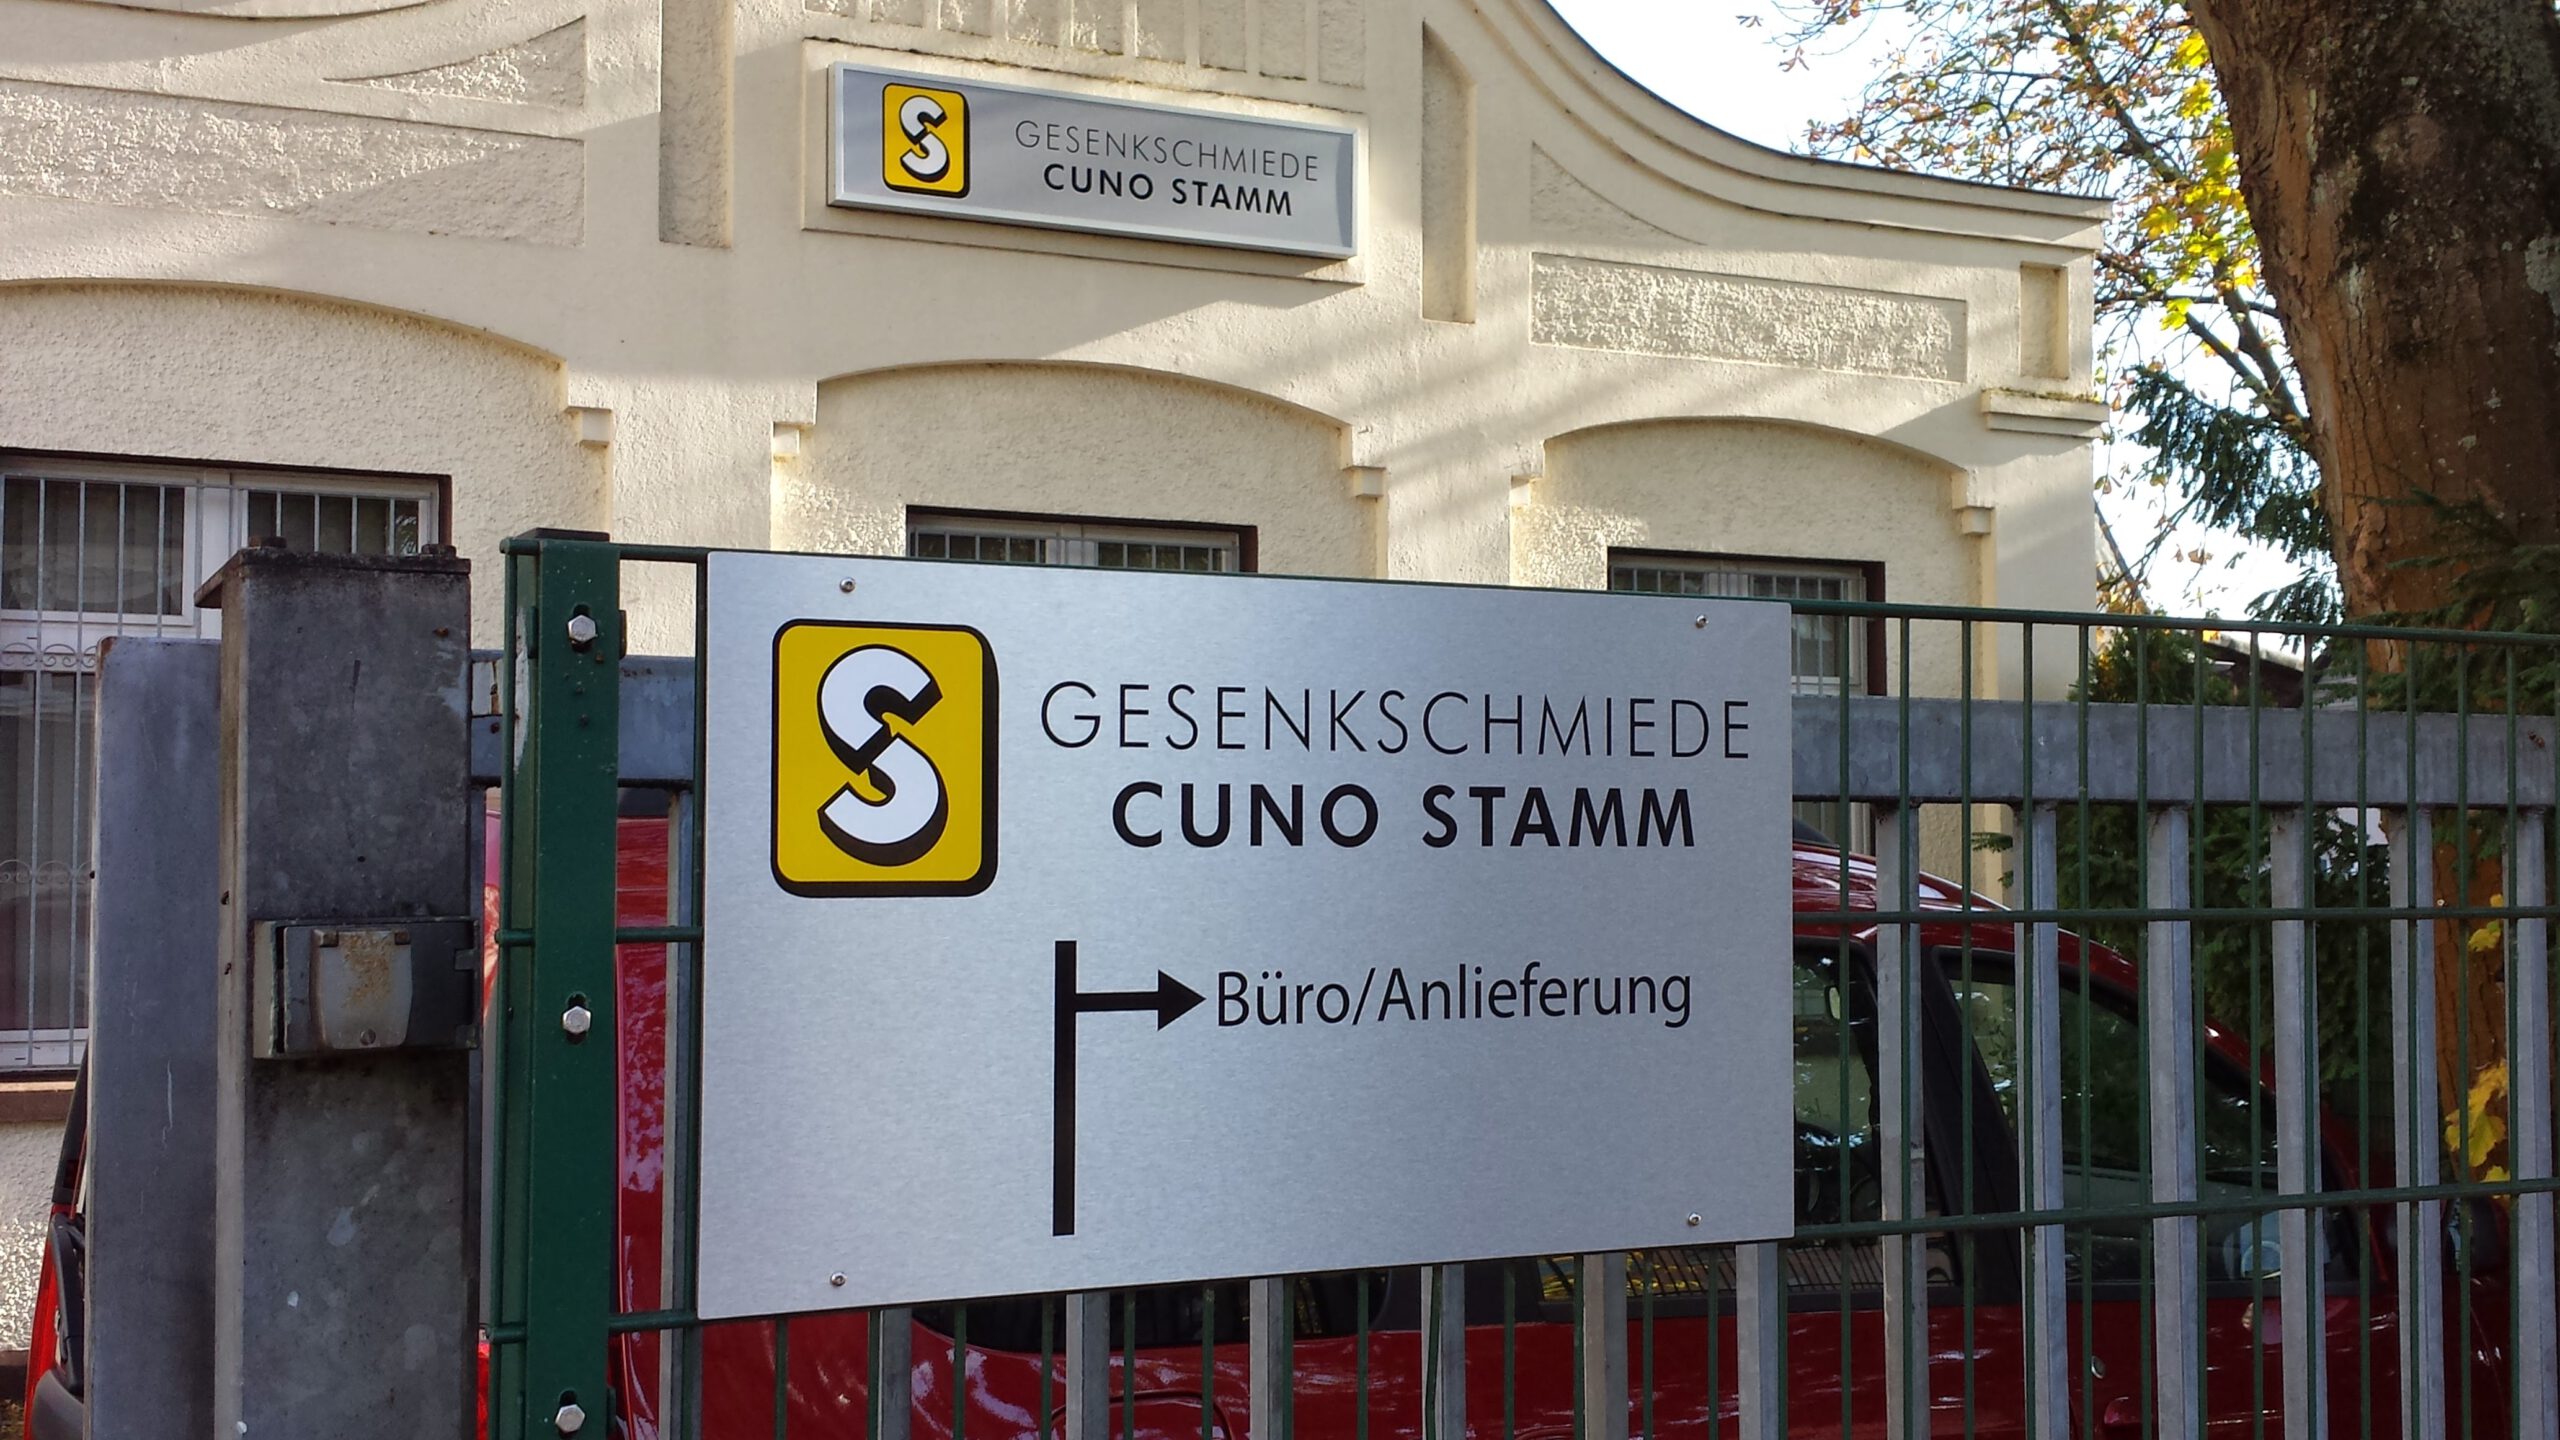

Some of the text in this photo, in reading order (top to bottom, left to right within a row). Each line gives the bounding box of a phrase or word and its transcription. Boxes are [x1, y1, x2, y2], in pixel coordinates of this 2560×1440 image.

[1015, 119, 1319, 182] GESENKSCHMIEDE
[1043, 163, 1293, 217] CUNO STAMM
[1041, 680, 1751, 760] GESENKSCHMIEDE
[1112, 780, 1696, 849] CUNO STAMM
[1215, 960, 1693, 1029] Büro/Anlieferung
